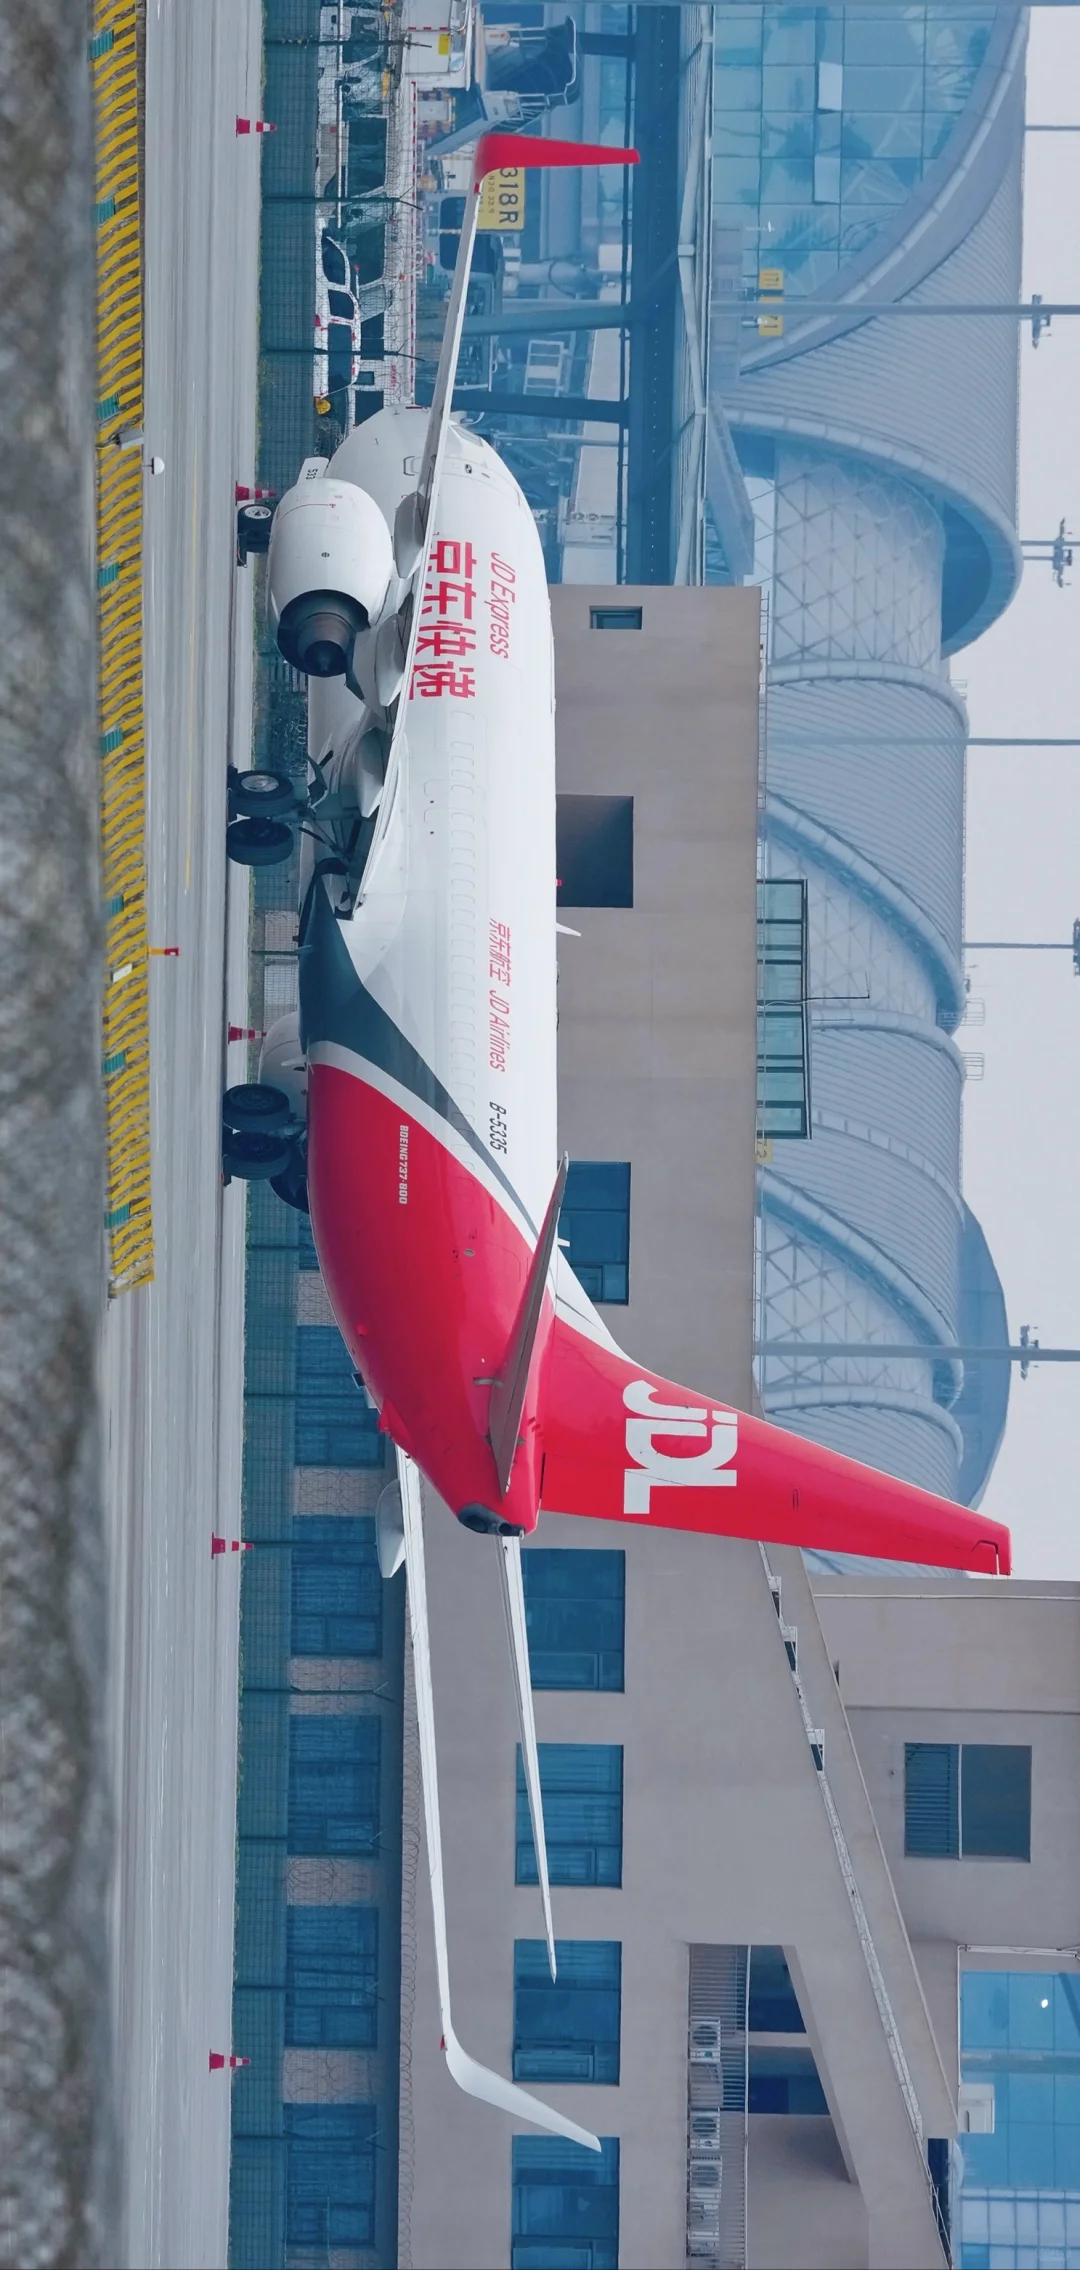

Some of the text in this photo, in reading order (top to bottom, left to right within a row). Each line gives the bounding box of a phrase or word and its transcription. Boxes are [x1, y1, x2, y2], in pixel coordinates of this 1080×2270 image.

[499, 167, 519, 224] 318R
[305, 468, 319, 480] 533
[408, 540, 477, 701] 京东快递
[483, 552, 516, 659] JD Express
[488, 917, 512, 987] 京东航空
[489, 989, 511, 1073] JD Airlines
[399, 1124, 409, 1161] BOEING
[488, 1101, 508, 1155] B-5335
